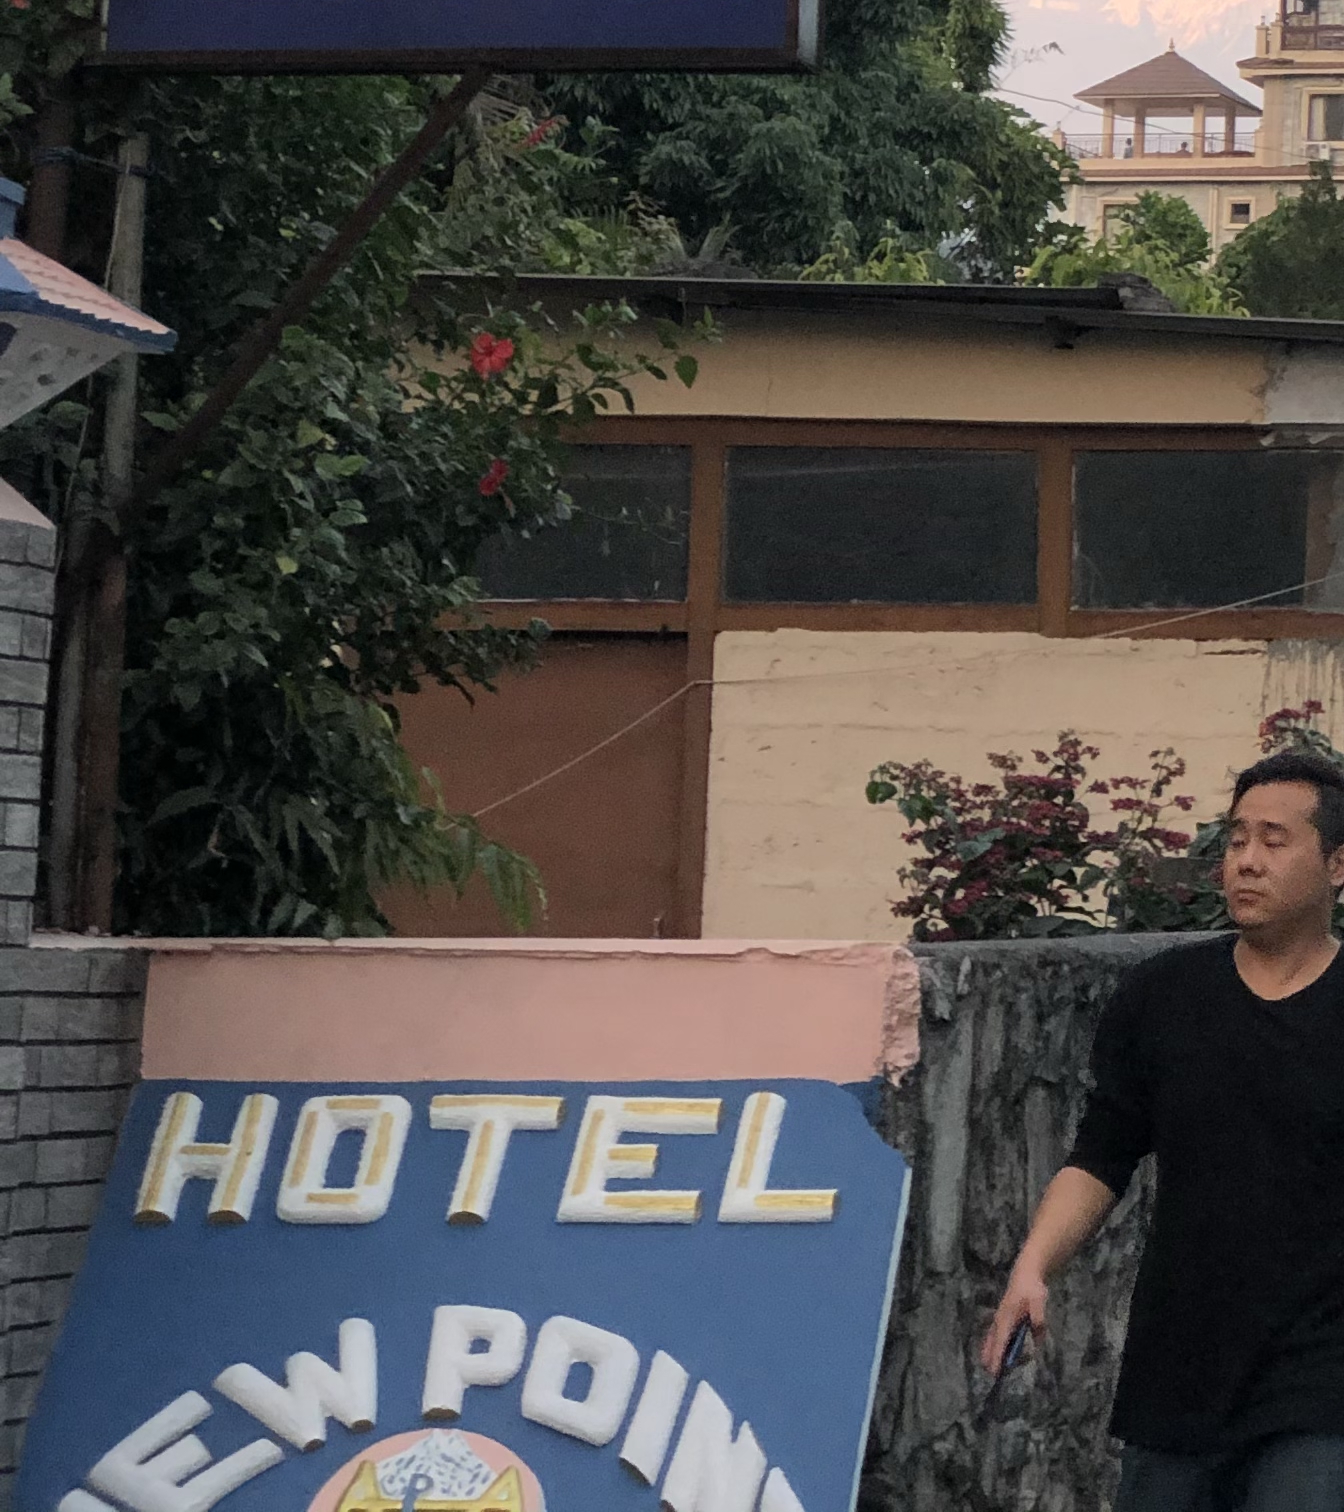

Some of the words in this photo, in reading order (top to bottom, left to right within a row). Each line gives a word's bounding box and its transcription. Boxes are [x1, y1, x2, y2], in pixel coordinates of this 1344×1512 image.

[132, 1090, 841, 1226] HOTEL
[56, 1317, 379, 1512] EW
[421, 1303, 805, 1512] POIN
